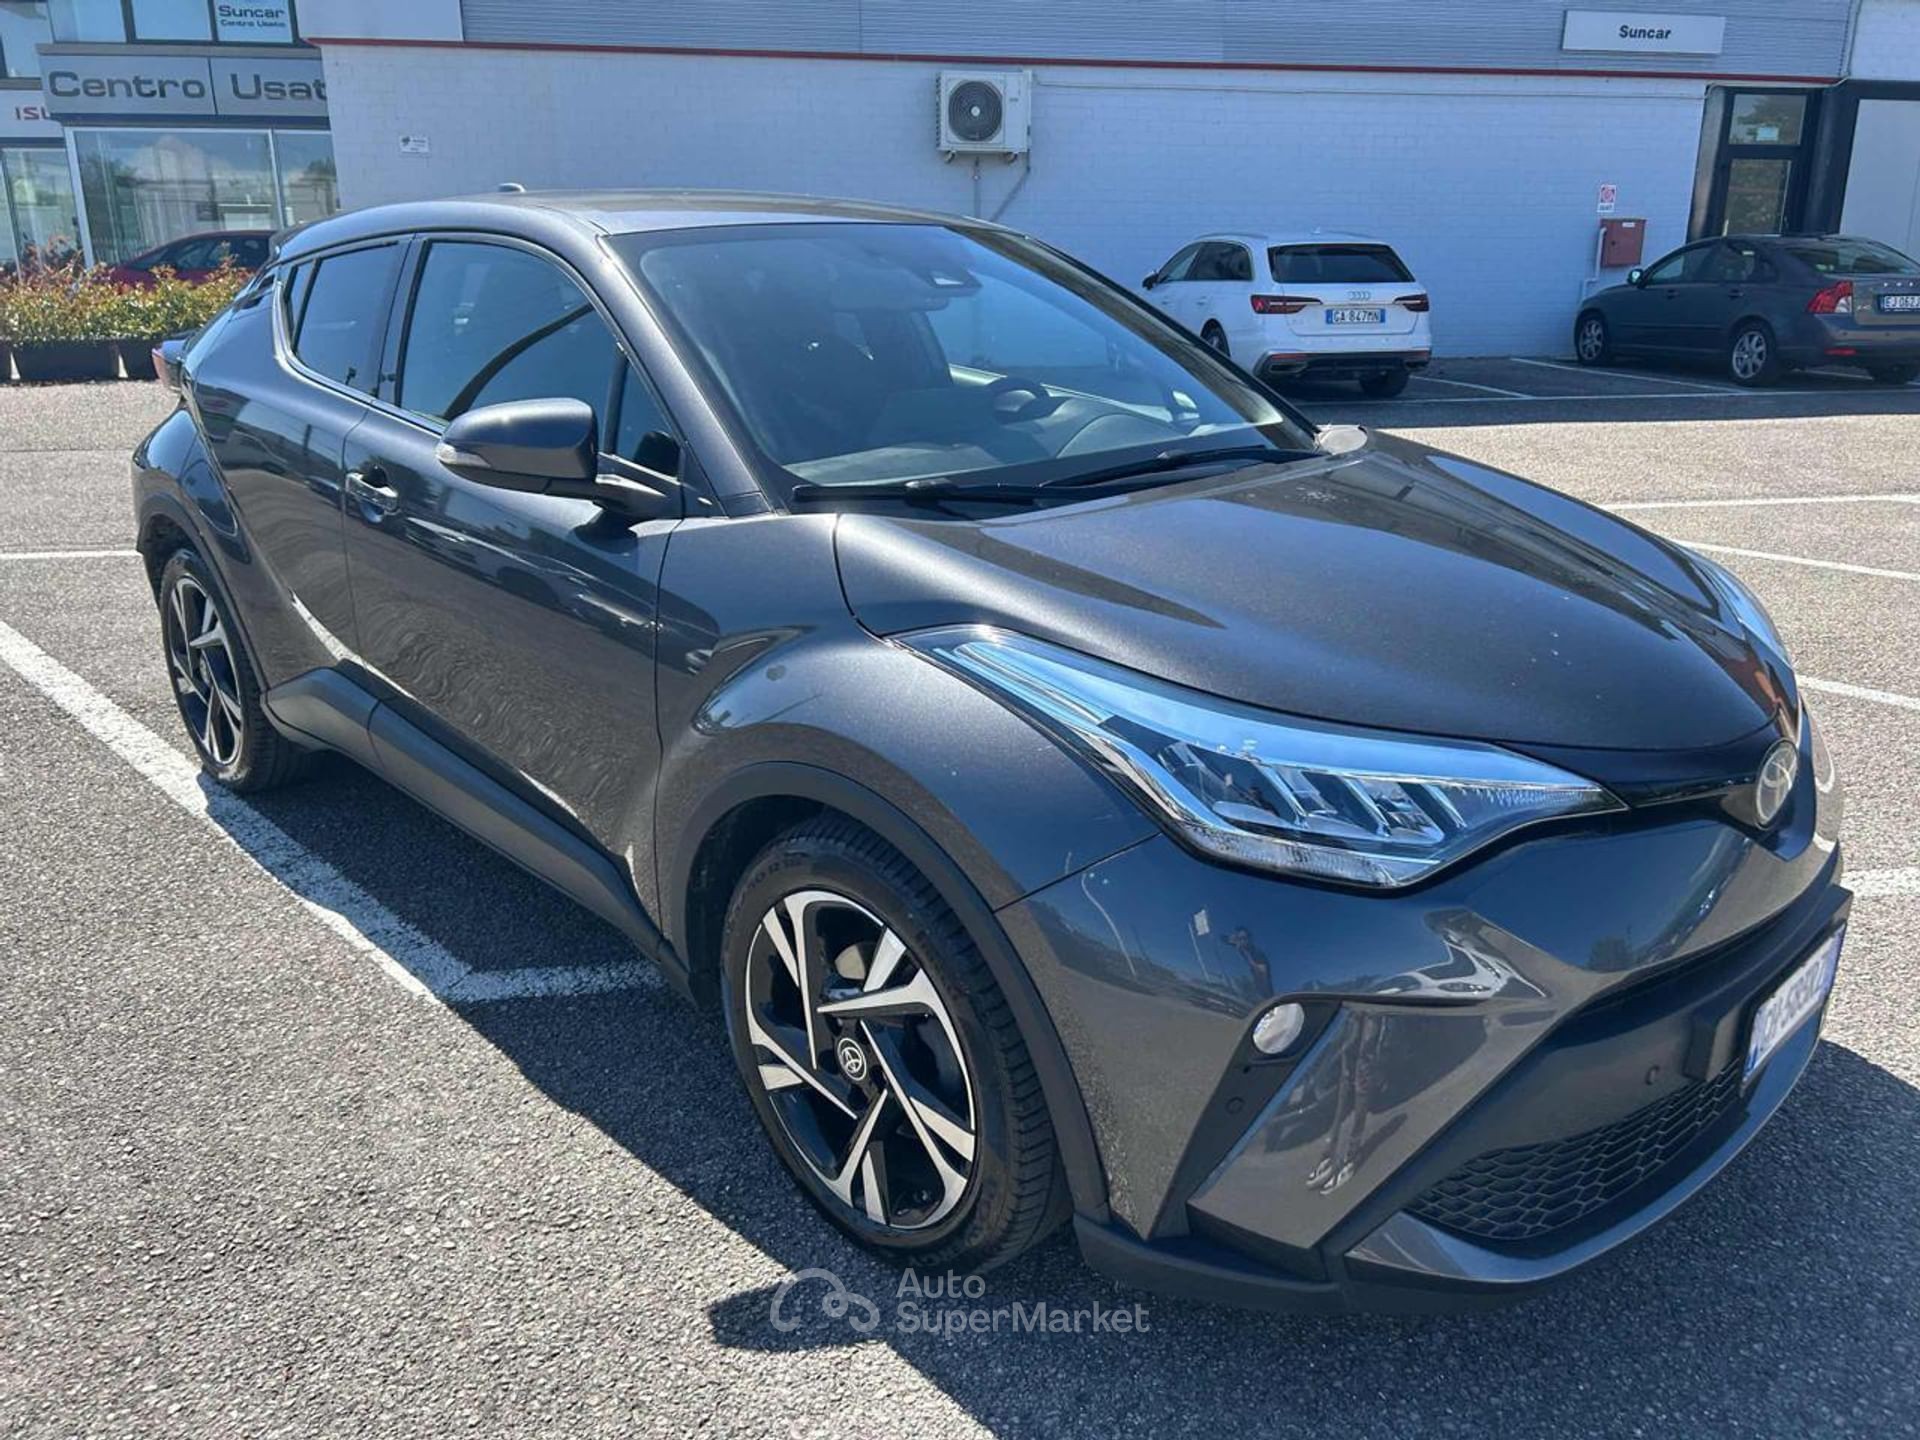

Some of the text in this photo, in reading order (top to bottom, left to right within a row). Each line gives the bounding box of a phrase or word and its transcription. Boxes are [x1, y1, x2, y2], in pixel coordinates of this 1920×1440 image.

[218, 5, 285, 18] Suncar
[1619, 25, 1671, 39] Suncar
[49, 71, 205, 99] Centro
